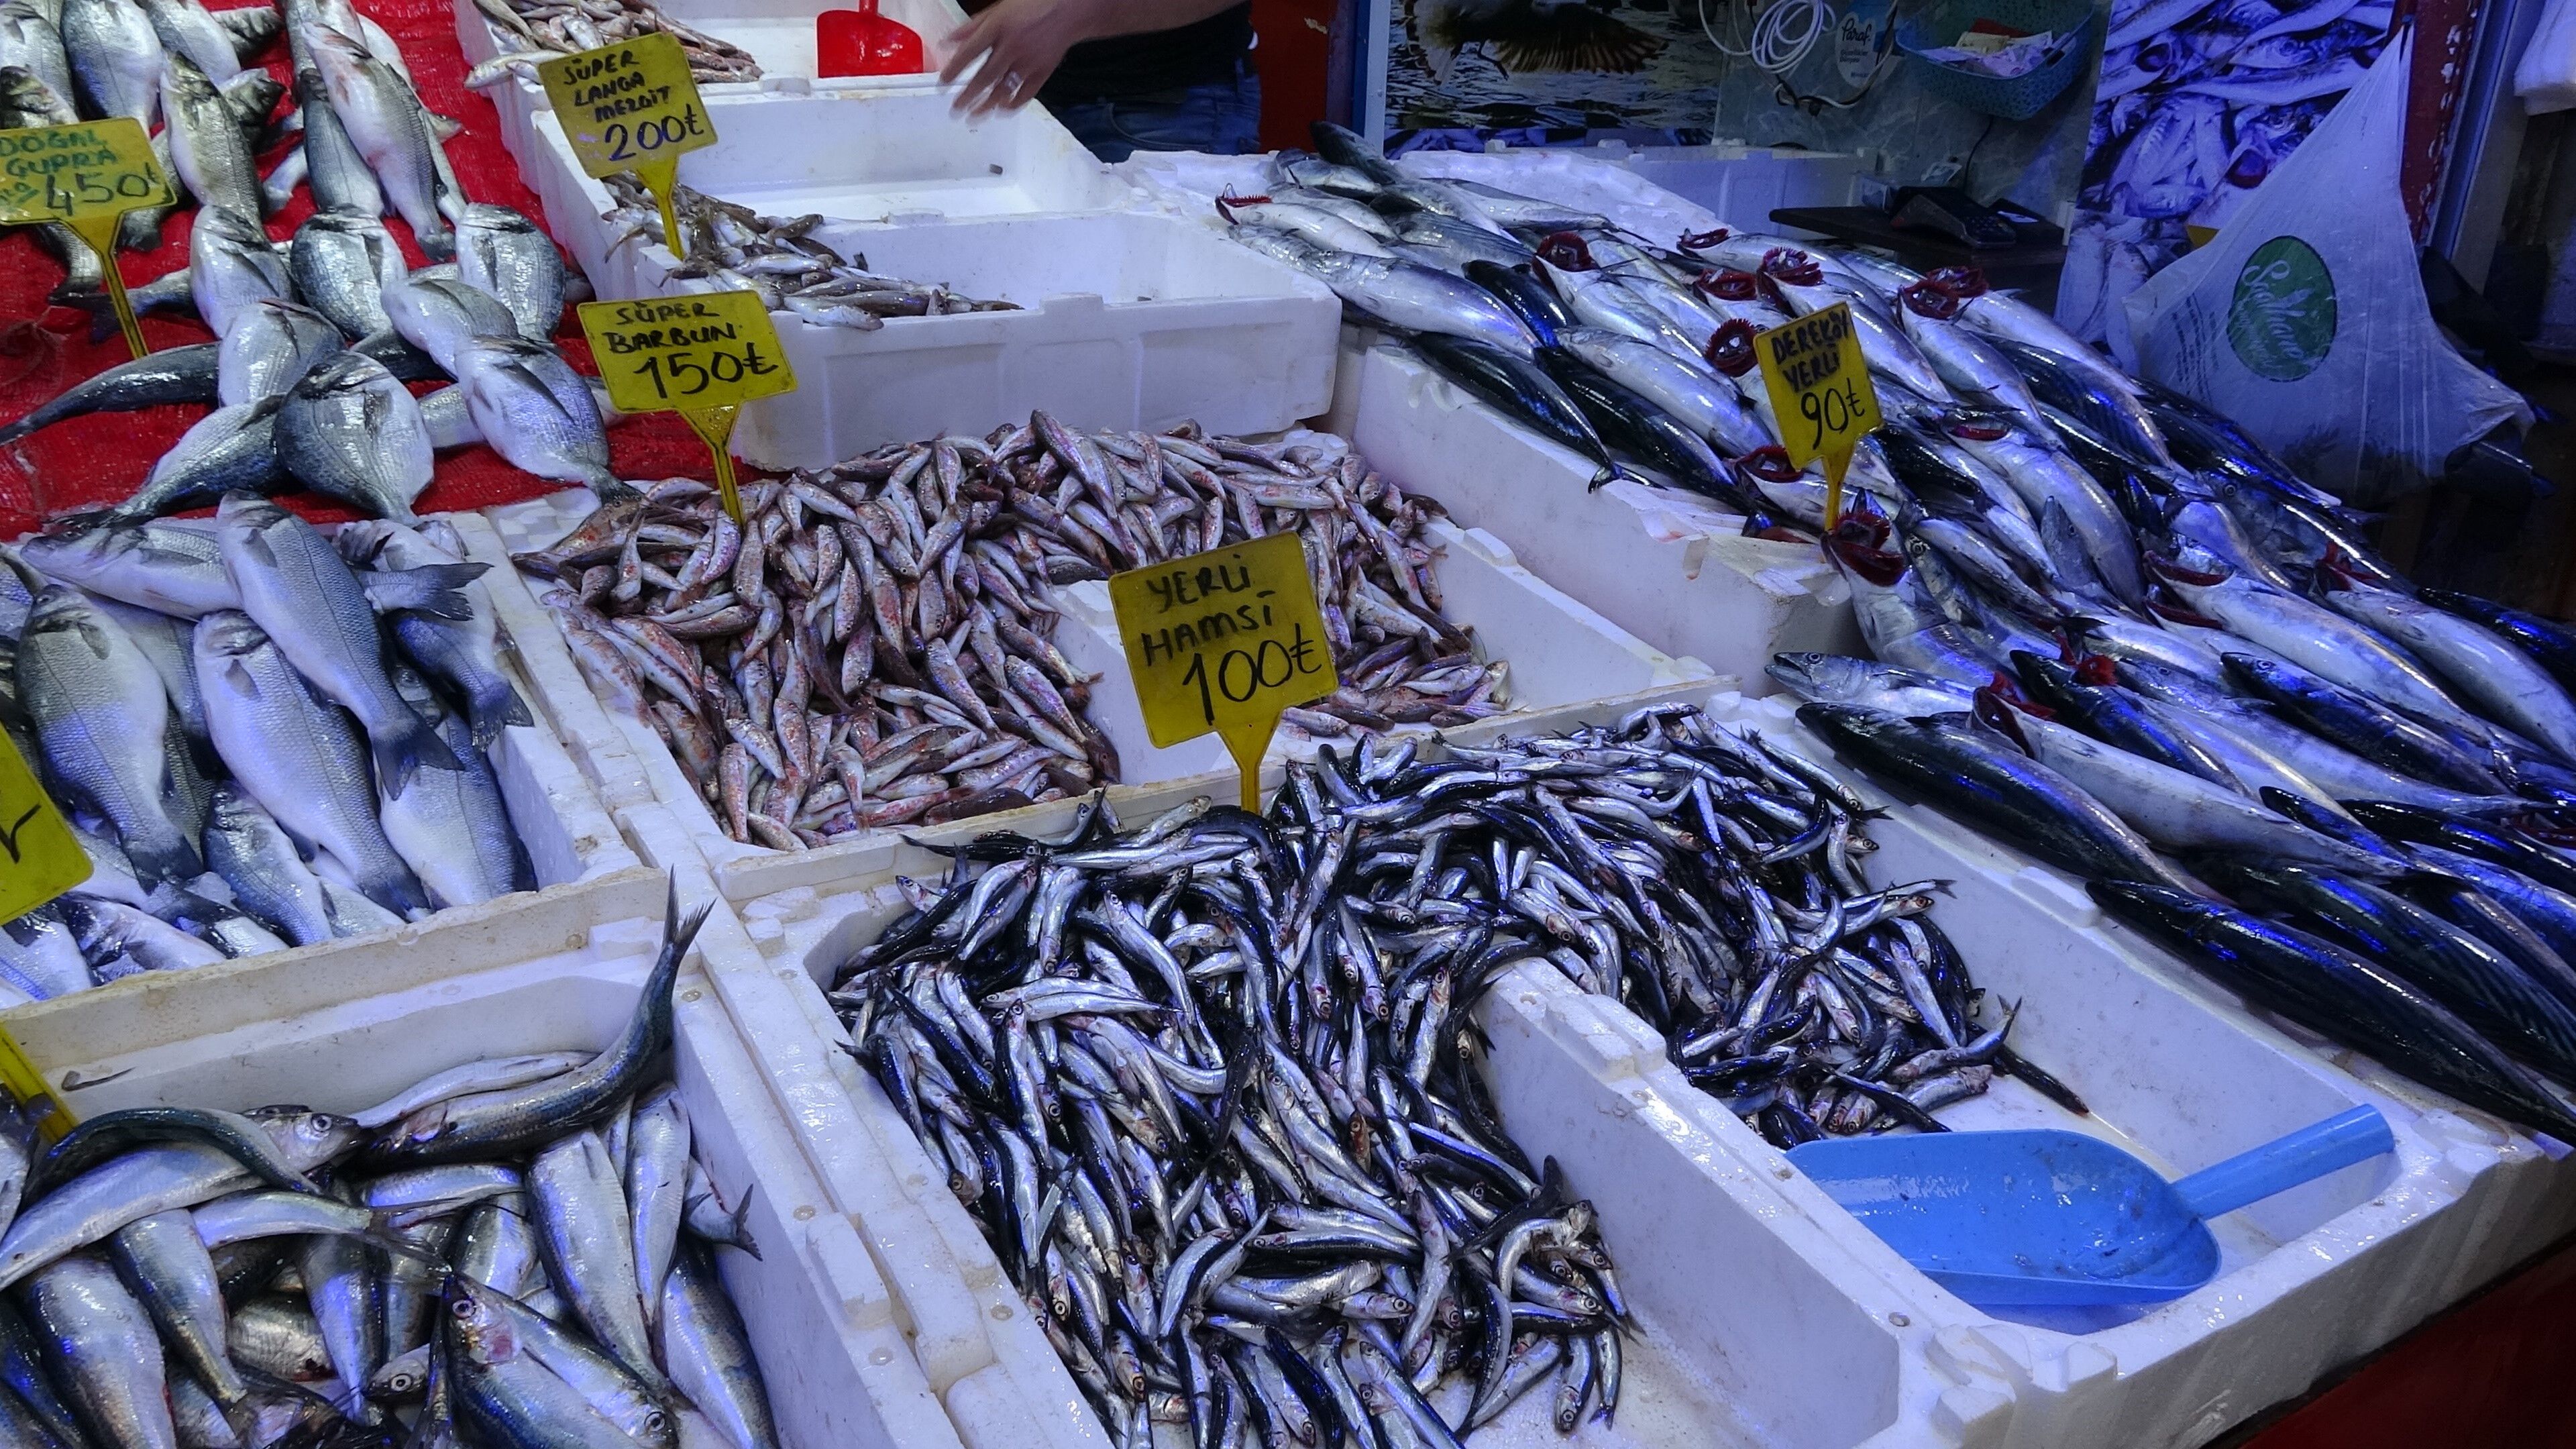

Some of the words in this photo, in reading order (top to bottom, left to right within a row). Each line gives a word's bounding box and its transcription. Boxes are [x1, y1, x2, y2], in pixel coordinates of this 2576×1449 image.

[564, 50, 639, 85] SÜPER
[616, 302, 720, 325] SÜPER
[602, 323, 737, 354] BARBUN
[1146, 554, 1251, 613] YERLİ
[1142, 590, 1275, 666] HAMSİ
